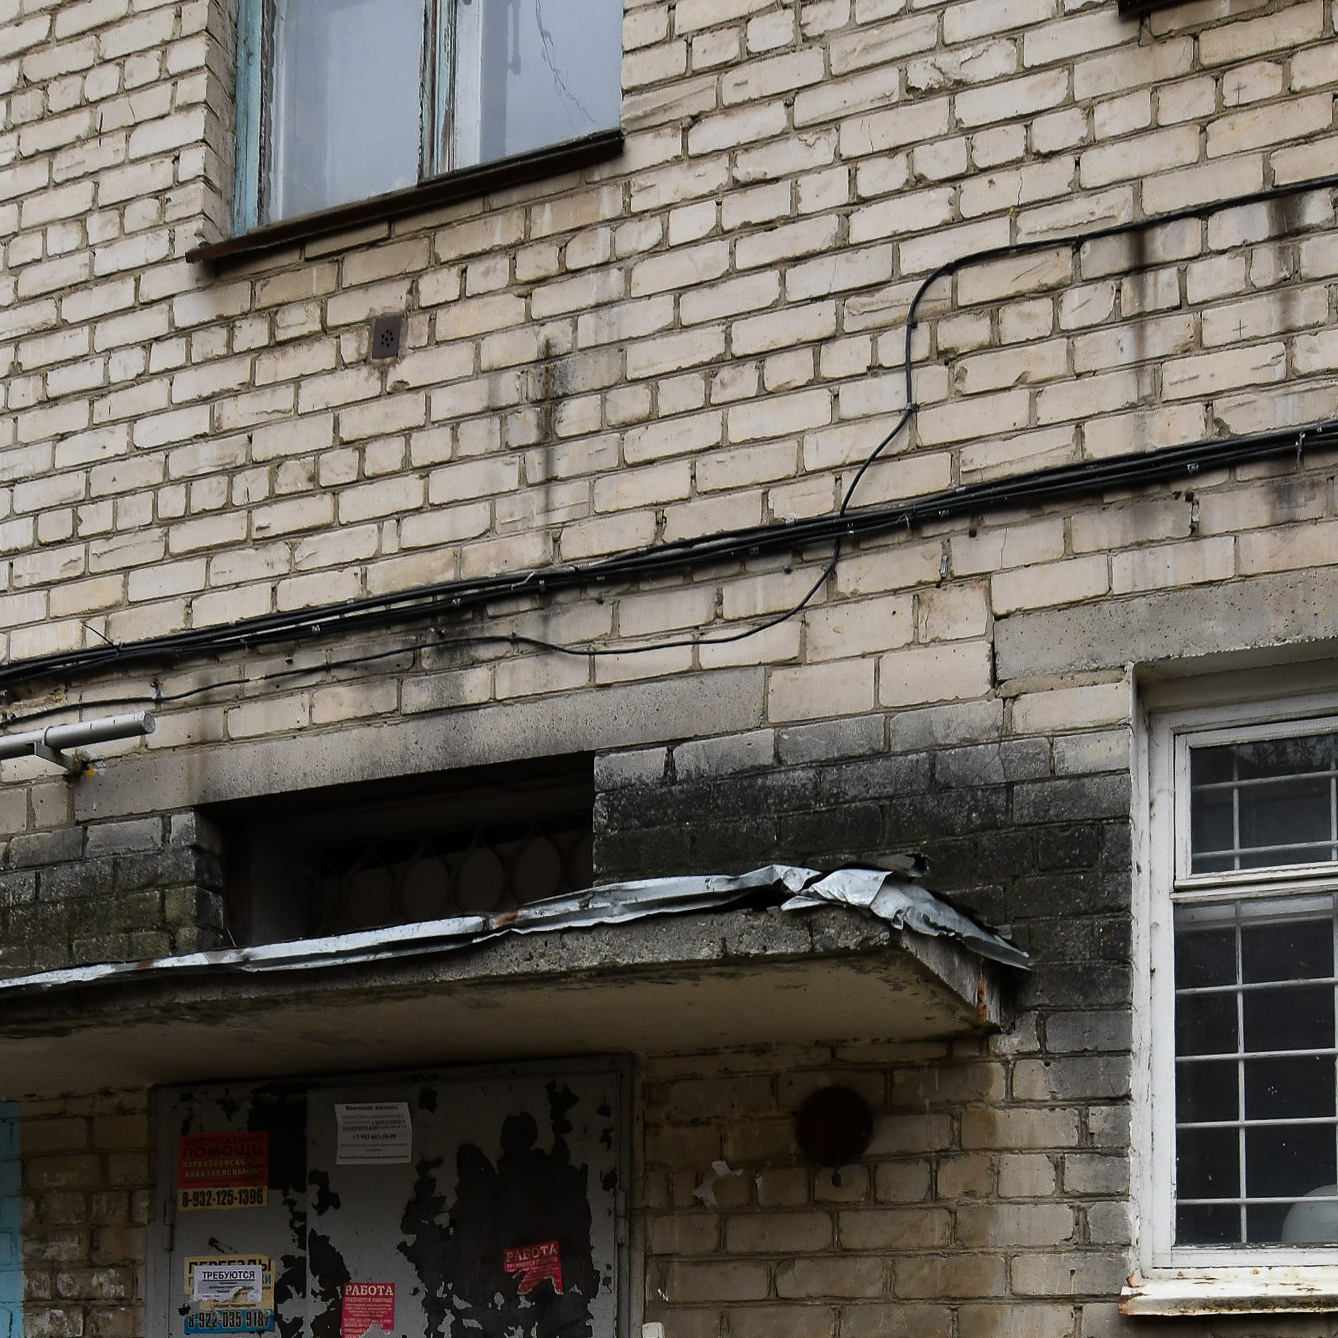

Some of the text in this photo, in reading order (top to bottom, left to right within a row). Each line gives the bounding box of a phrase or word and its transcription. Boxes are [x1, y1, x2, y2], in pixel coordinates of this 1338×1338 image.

[183, 1144, 263, 1159] ПОМОЩЬ
[182, 1188, 263, 1208] 8-932-125-1396
[506, 1243, 559, 1262] РАБОТА
[202, 1270, 255, 1280] ТРЕБУЮТСЯ
[345, 1284, 394, 1296] РАБОТА
[188, 1311, 269, 1328] 8-922-035-9187
